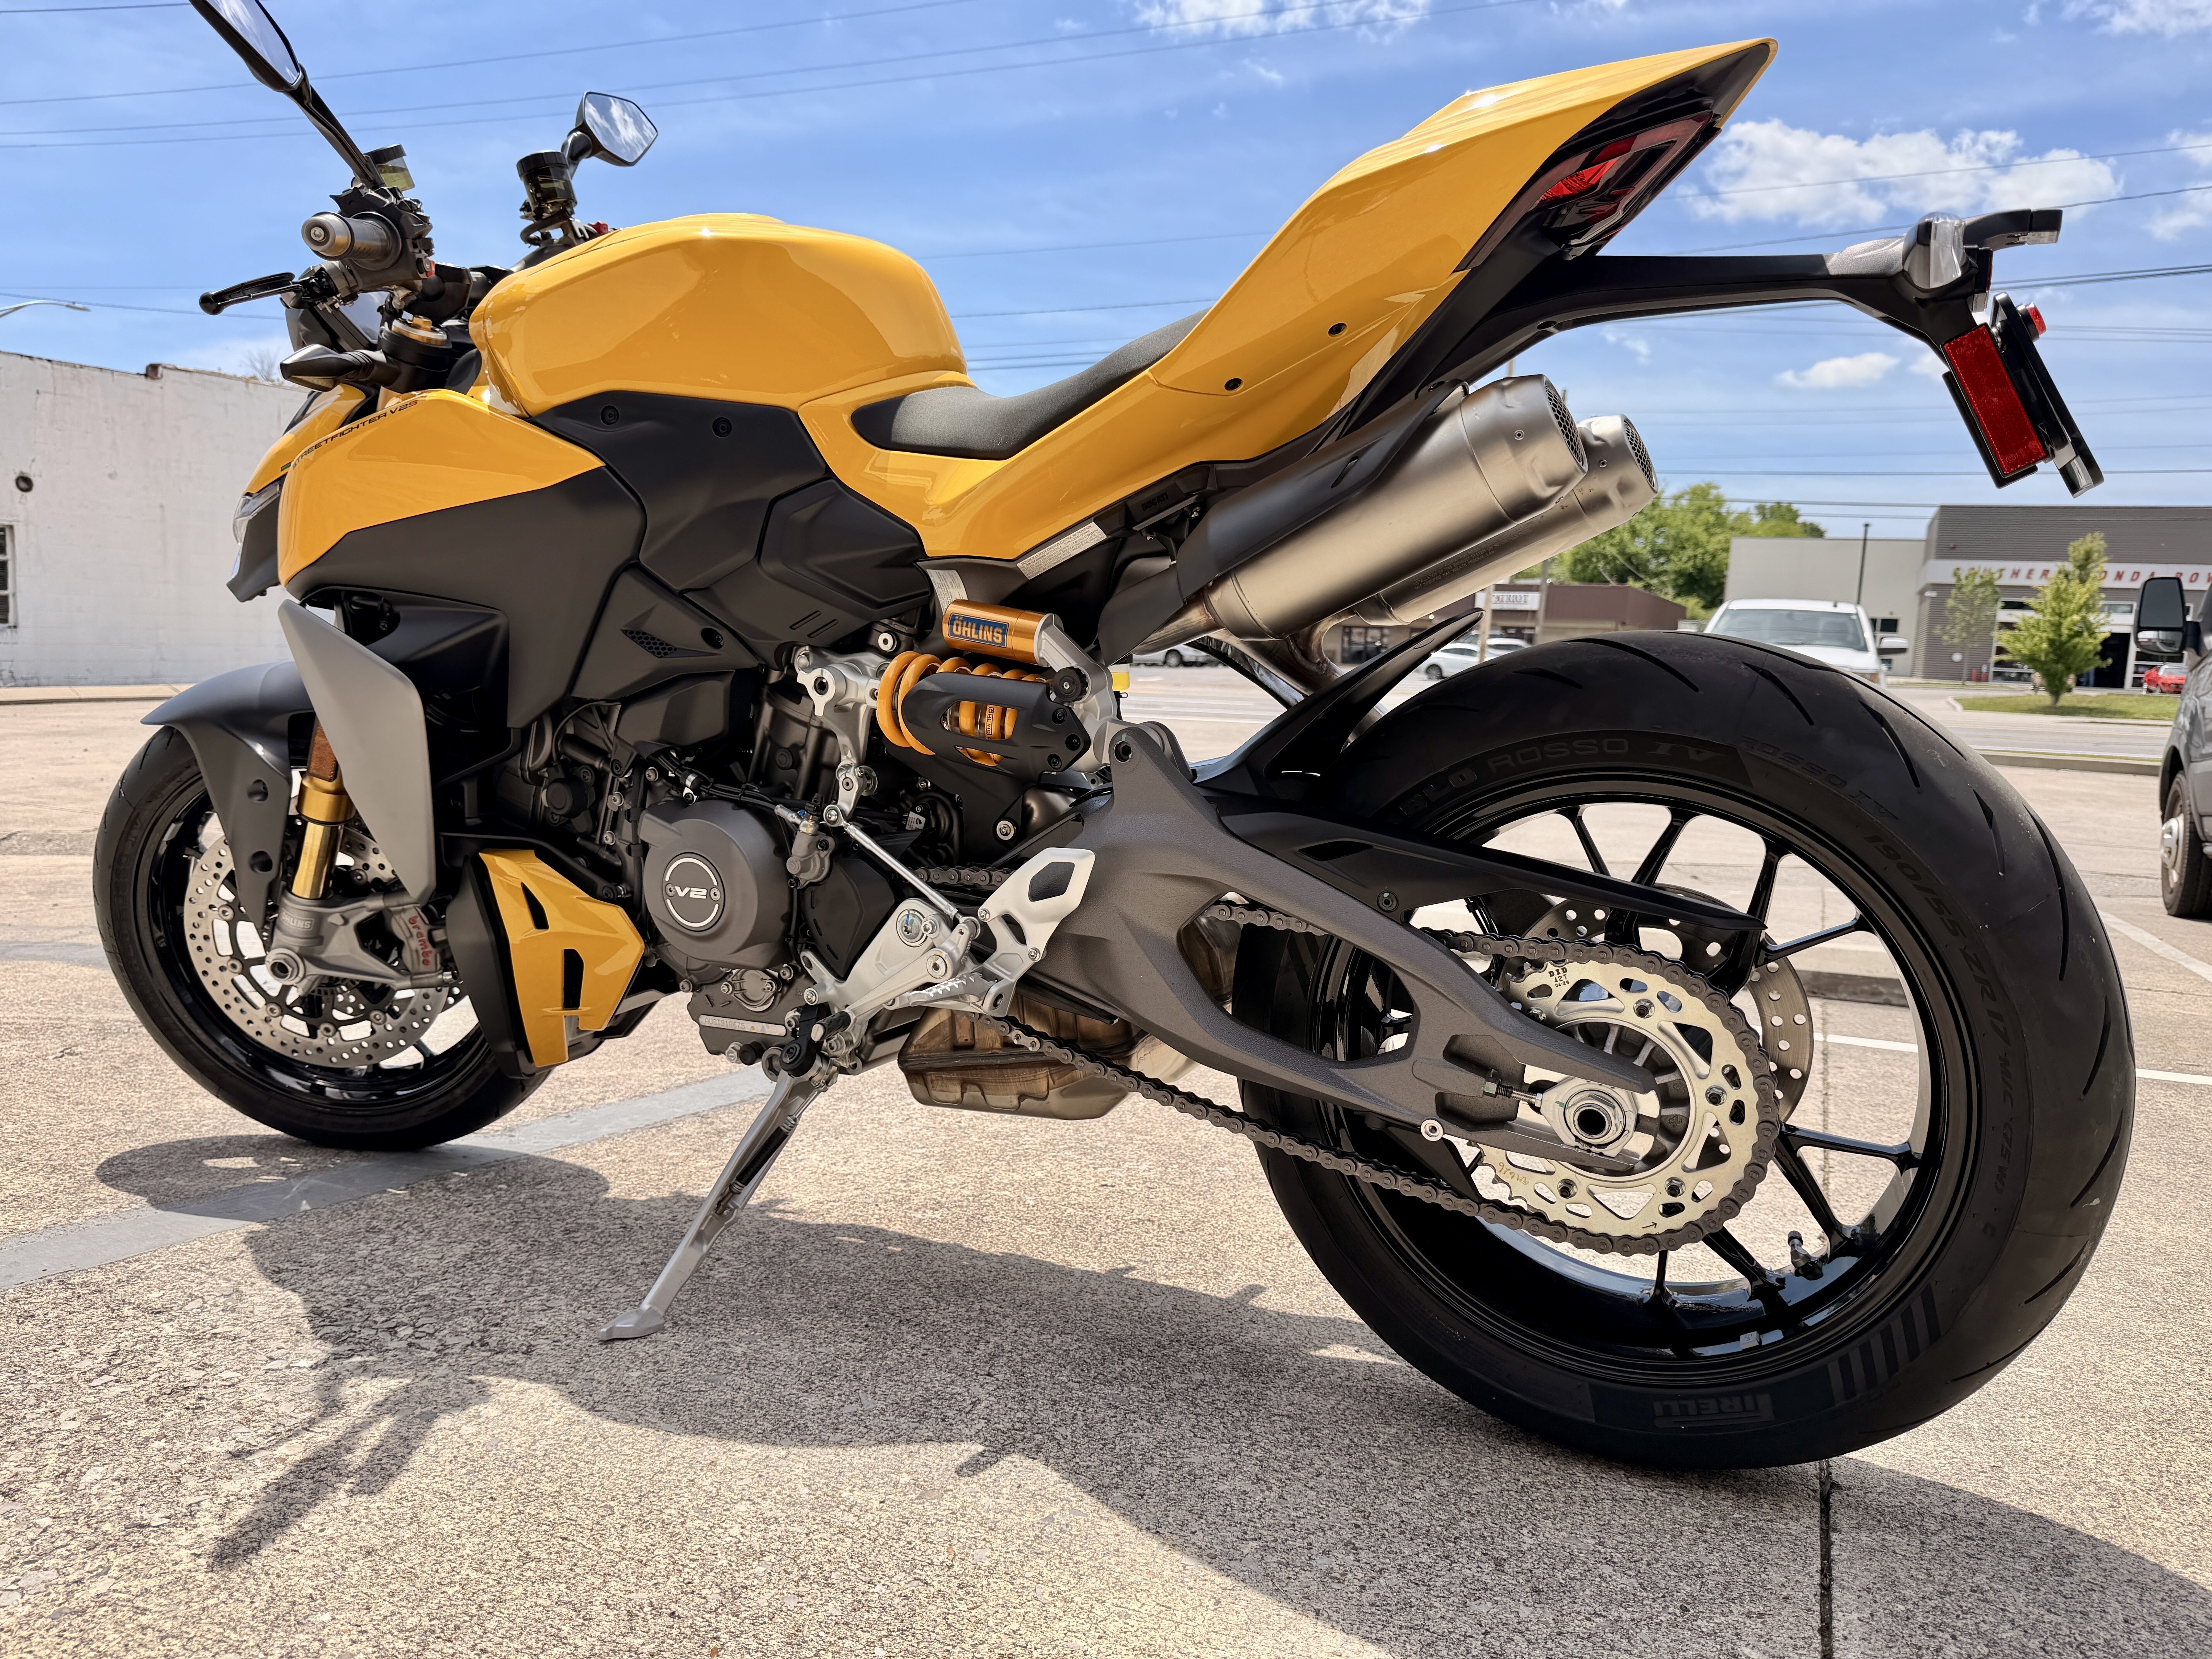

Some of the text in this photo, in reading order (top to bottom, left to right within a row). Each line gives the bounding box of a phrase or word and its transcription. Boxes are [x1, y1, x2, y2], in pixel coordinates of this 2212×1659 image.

[293, 412, 387, 469] STREETFIGHTER
[1141, 492, 1169, 512] DUCATI
[952, 616, 1003, 644] ÖHLINS
[1486, 738, 1629, 775] ROSSO
[1645, 740, 1729, 763] IV
[1733, 735, 1848, 789] ROSSO
[674, 886, 708, 900] V2
[1862, 834, 1967, 940] 190/55
[1554, 974, 1567, 982] 42T
[1653, 1393, 1775, 1429] PIRELLI
